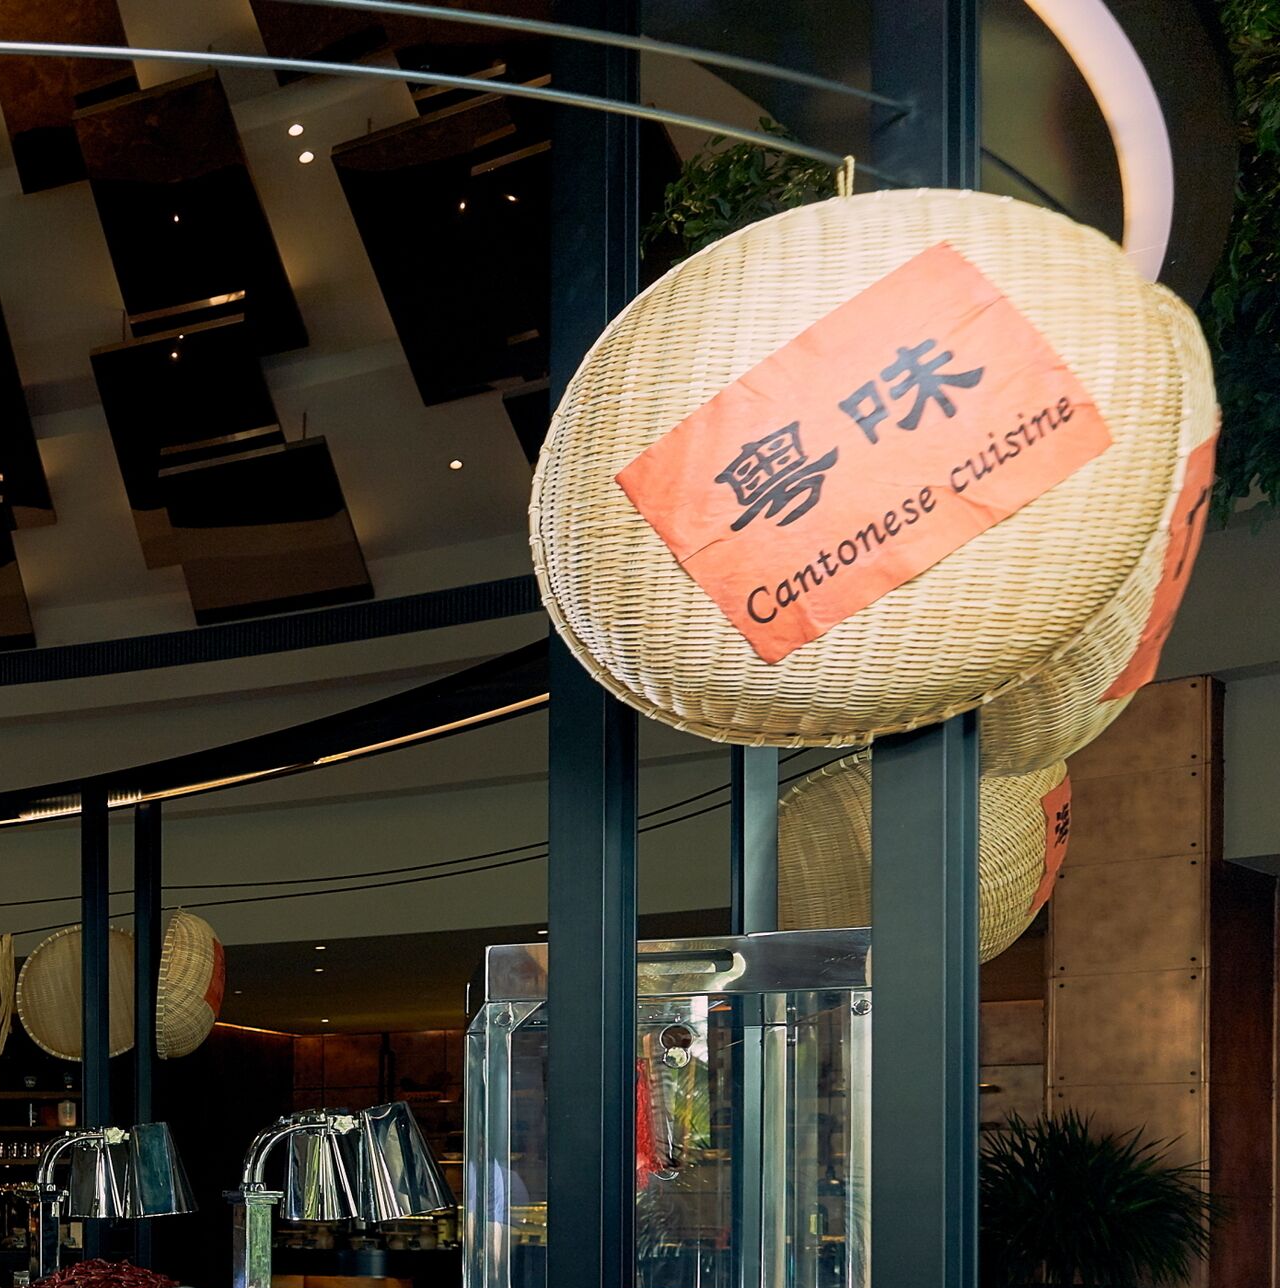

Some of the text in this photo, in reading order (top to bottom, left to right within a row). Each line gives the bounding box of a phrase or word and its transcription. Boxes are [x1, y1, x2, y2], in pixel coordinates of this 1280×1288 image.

[713, 338, 986, 531] 粤味
[746, 396, 1075, 624] Cantonese cuisine
